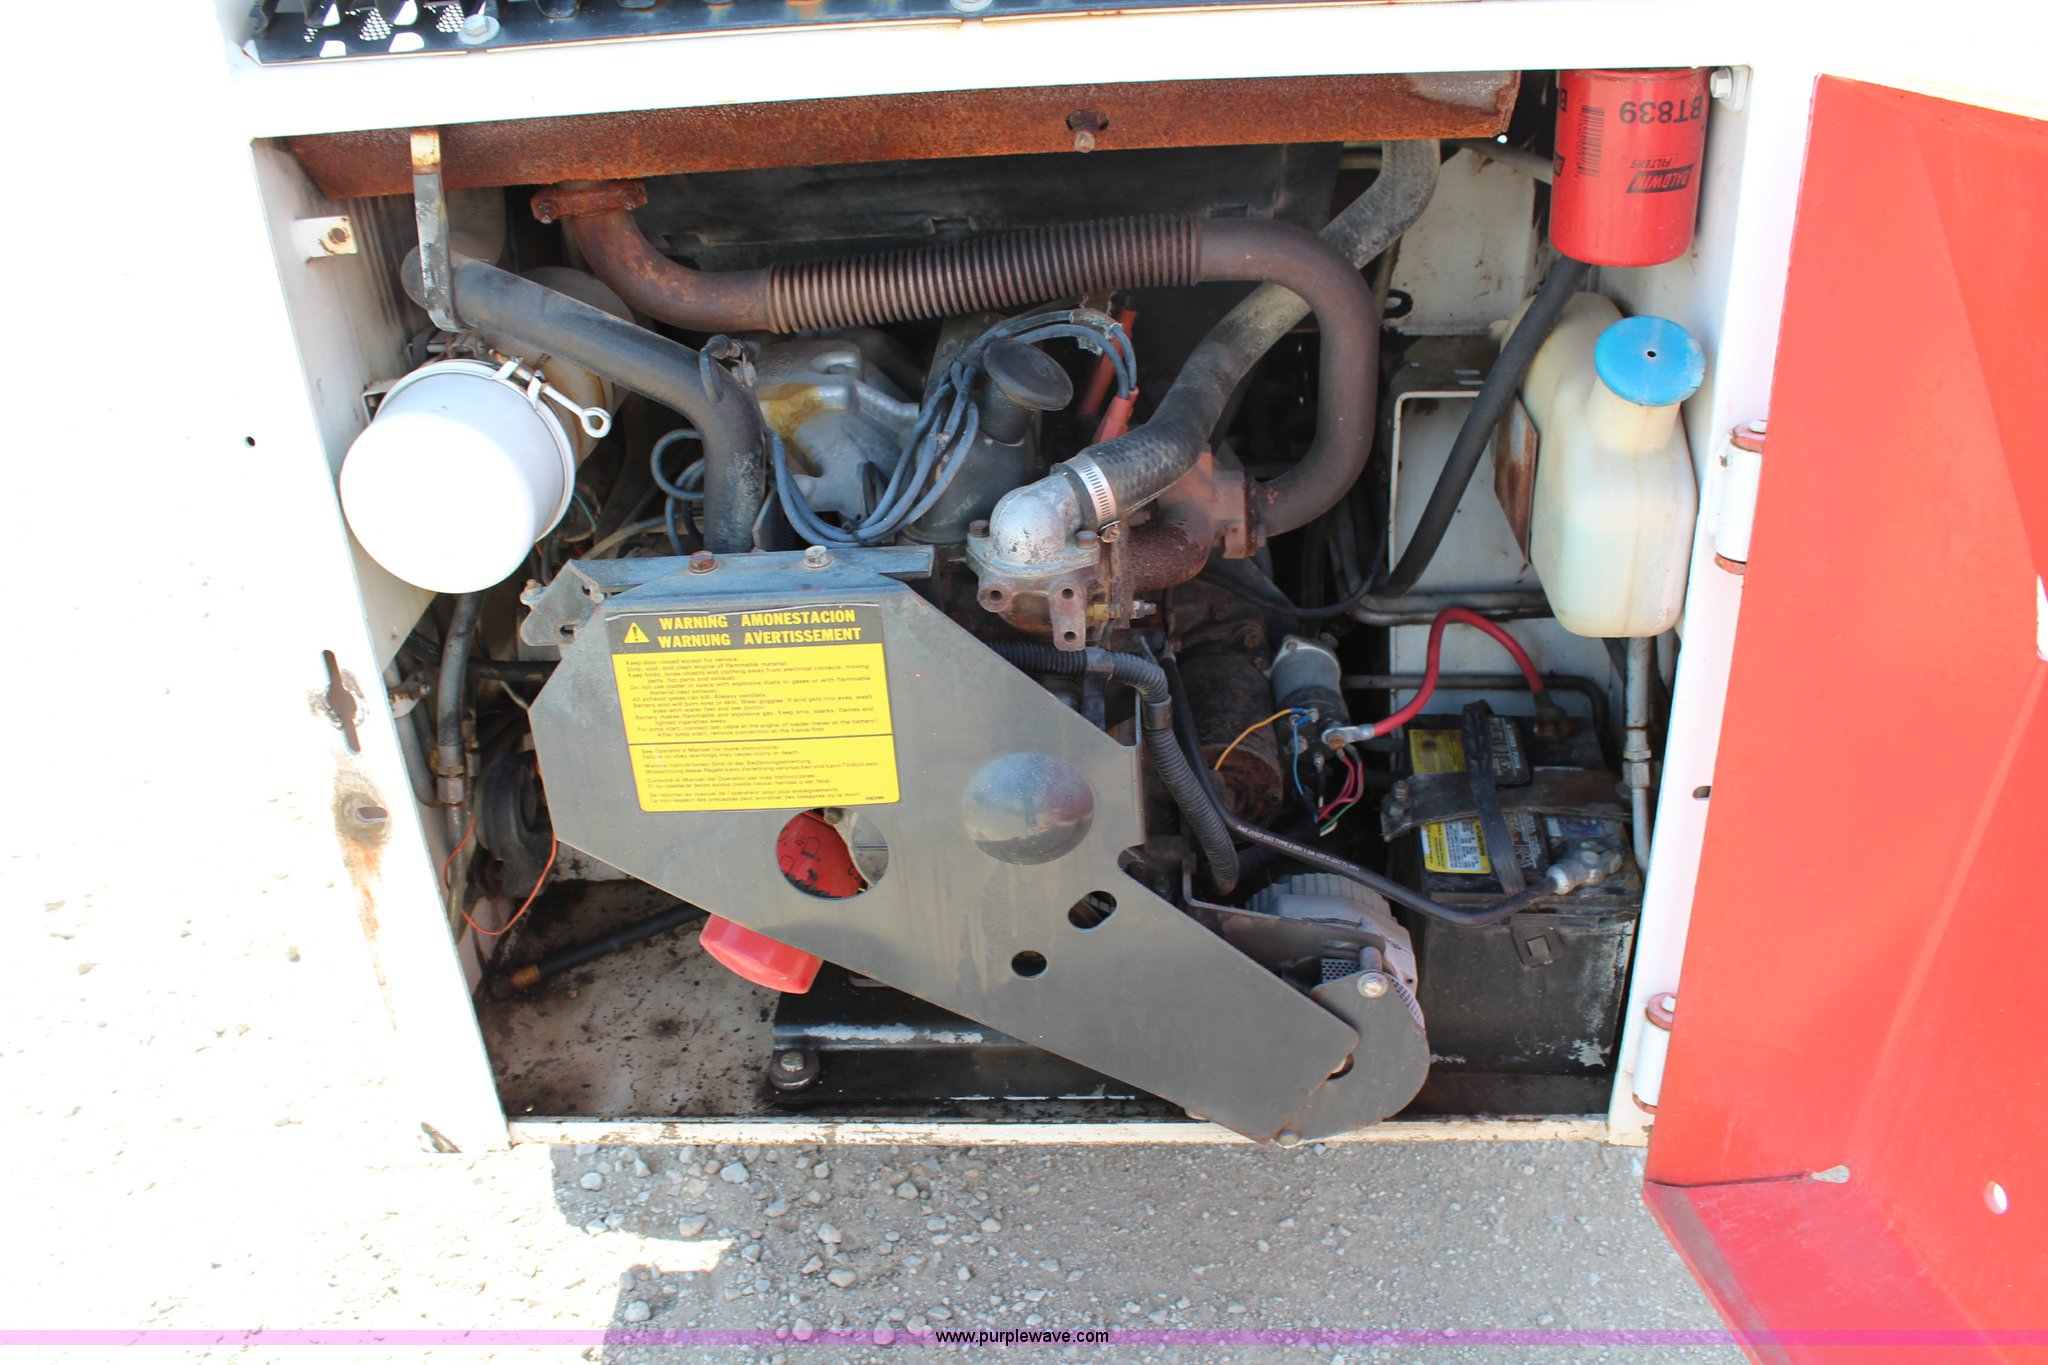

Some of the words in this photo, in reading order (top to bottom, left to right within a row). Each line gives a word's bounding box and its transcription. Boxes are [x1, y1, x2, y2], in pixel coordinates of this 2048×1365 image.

[1619, 96, 1705, 124] BT839
[1631, 157, 1672, 169] FILTERS
[1630, 167, 1693, 191] BALDWIN
[658, 615, 728, 631] WARNING
[658, 633, 731, 649] WARNUNG
[744, 627, 862, 645] AVERTISSEMENT
